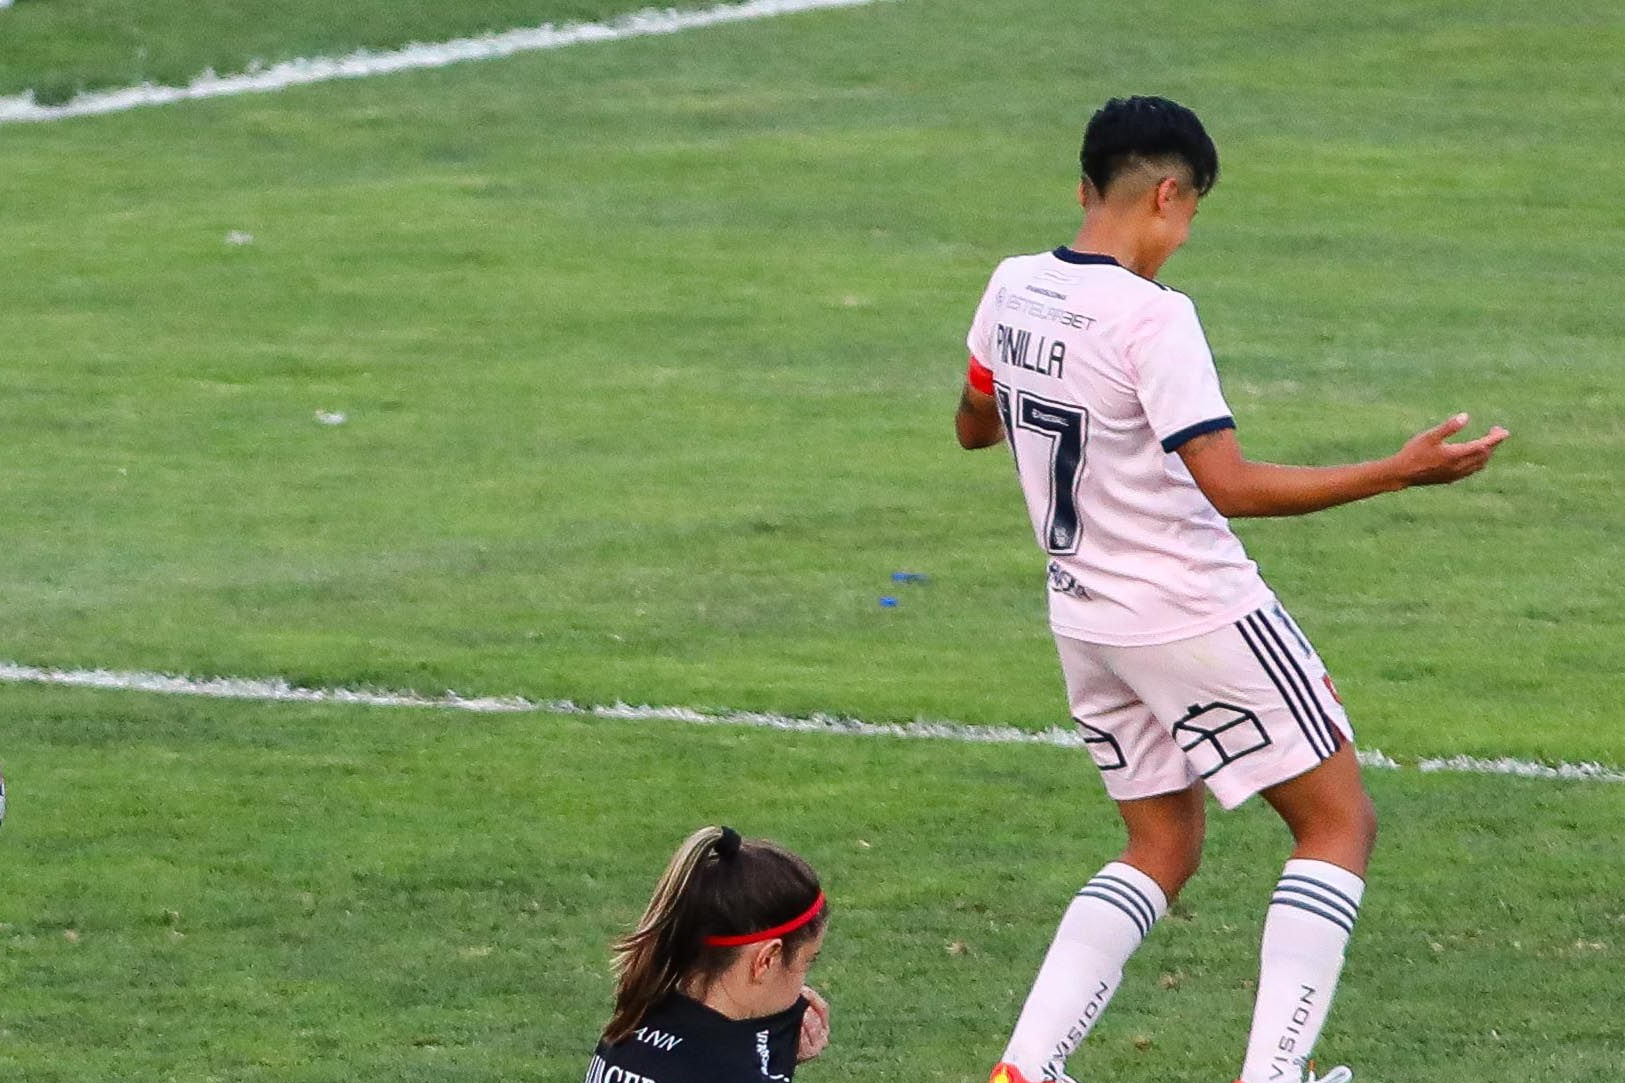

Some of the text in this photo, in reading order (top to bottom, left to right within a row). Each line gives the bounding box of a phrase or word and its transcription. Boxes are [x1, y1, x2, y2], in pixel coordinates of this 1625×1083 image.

[996, 323, 1066, 379] PINILLA
[1052, 980, 1109, 1059] VISION
[1268, 984, 1316, 1080] VISION
